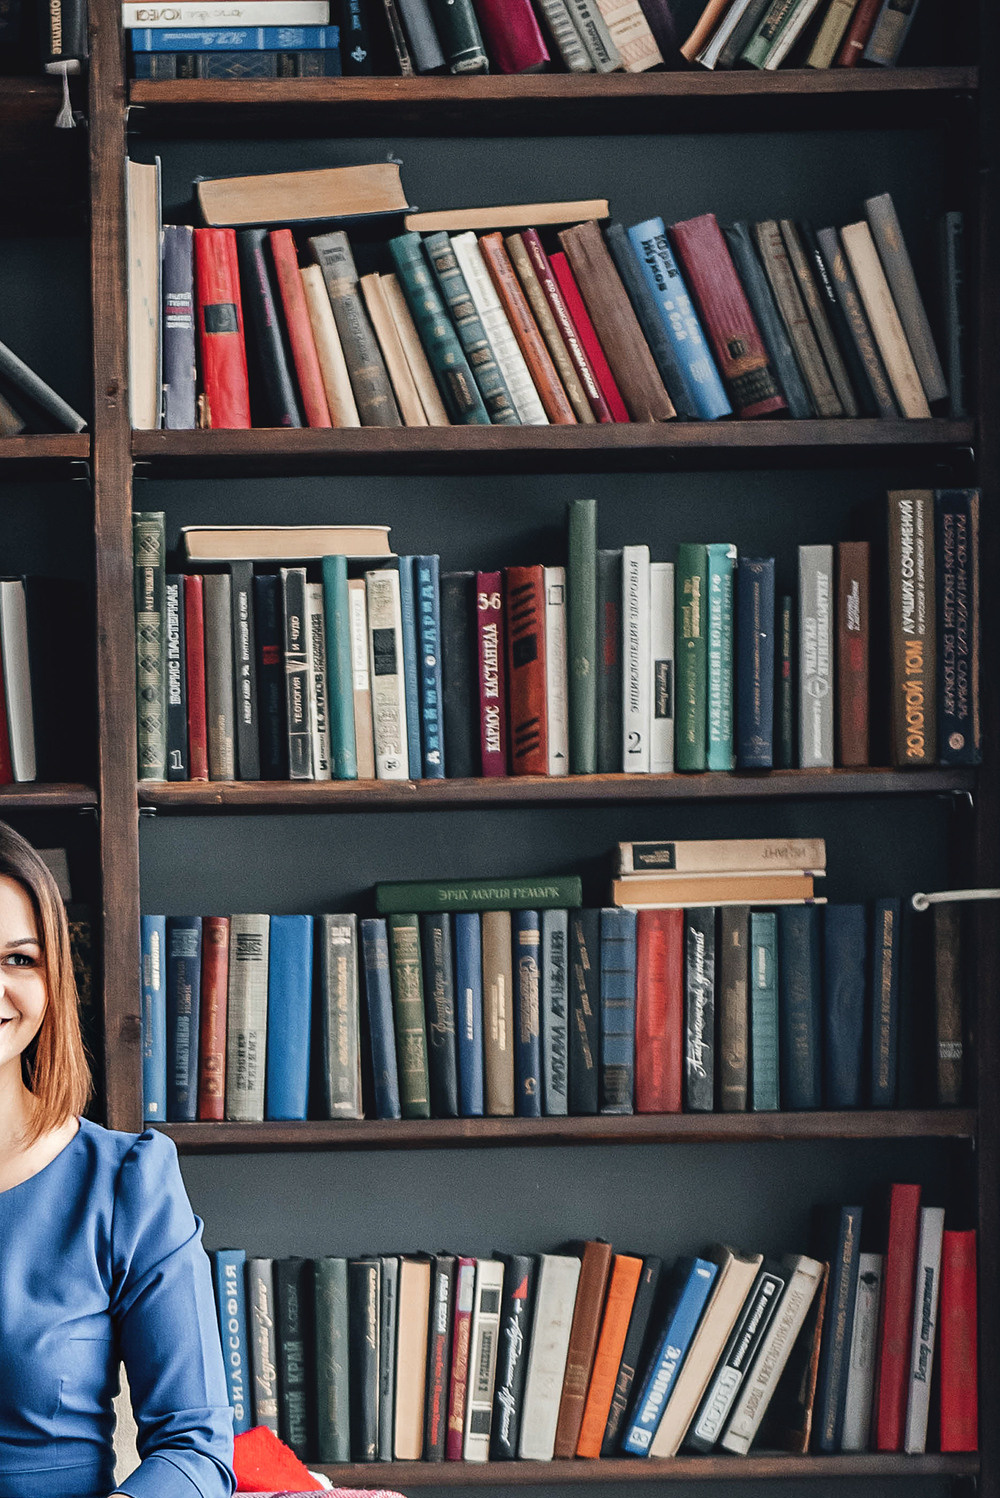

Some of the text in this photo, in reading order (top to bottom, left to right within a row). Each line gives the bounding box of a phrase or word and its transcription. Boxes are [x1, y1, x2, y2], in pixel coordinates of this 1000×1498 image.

[640, 237, 670, 293] Жуков
[654, 233, 679, 279] Юрий
[898, 499, 915, 633] ЛУЧШИХ СОЧИНЕНИЙ
[290, 615, 300, 639] ЧУДО
[478, 590, 502, 610] 5-6
[709, 595, 721, 646] КОДЕКС
[166, 582, 182, 704] БОРИС ПАСТЕРНАК
[419, 567, 440, 764] Джеймс Олдридж
[628, 560, 640, 713] ЭНЦИКЛОПЕДИЯ ЗДОРОВЬЯ
[292, 677, 303, 722] ТЕОЛОГИЯ
[481, 622, 501, 751] КАРЛОС КАСТАНЕДА
[709, 650, 722, 741] ГРАЖДАНСКИЙ
[901, 640, 925, 757] ЗОЛОТОЙ ТОМ
[169, 750, 183, 768] 1
[628, 731, 641, 754] 2
[438, 886, 559, 900] ЭРИХ МАРИЯ РЕМАРК
[550, 1026, 565, 1095] МИХАИЛ
[223, 1263, 246, 1420] ФИЛОСОФИЯ
